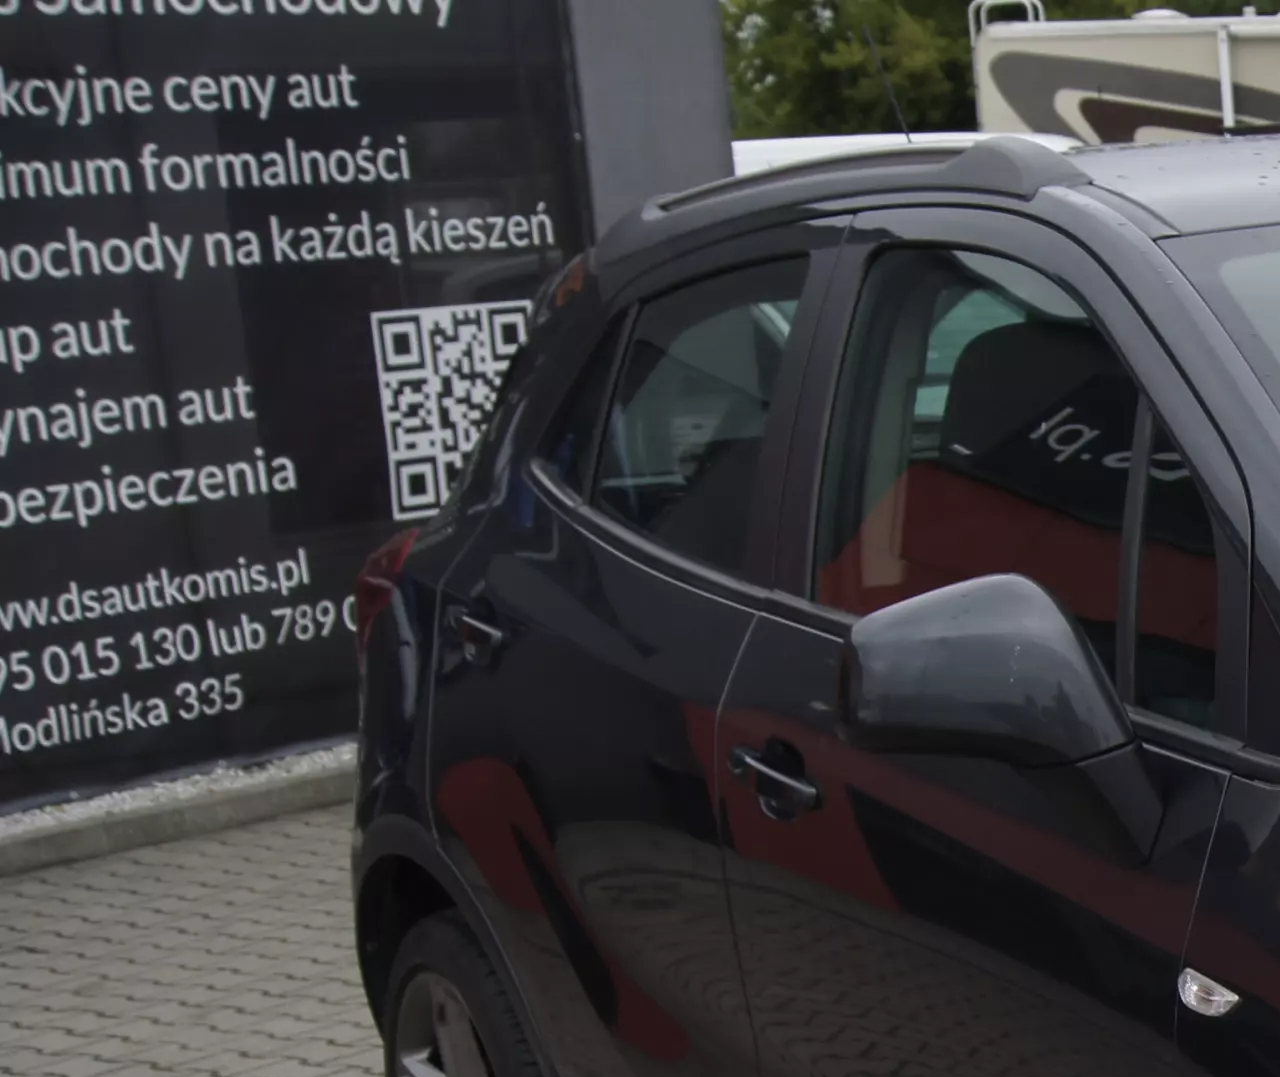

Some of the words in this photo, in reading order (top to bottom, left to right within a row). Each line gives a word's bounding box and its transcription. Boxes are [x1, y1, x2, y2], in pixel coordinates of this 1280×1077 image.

[163, 75, 276, 119] ceny
[287, 64, 359, 109] aut
[138, 134, 411, 192] formalności
[204, 230, 262, 267] na
[269, 209, 402, 265] każdą
[404, 201, 555, 253] kieszeń
[51, 308, 136, 359] aut
[178, 376, 256, 425] aut
[42, 636, 121, 686] 015
[129, 623, 202, 671] 130
[206, 613, 267, 657] lub
[271, 600, 336, 645] 789
[175, 673, 244, 720] 335
